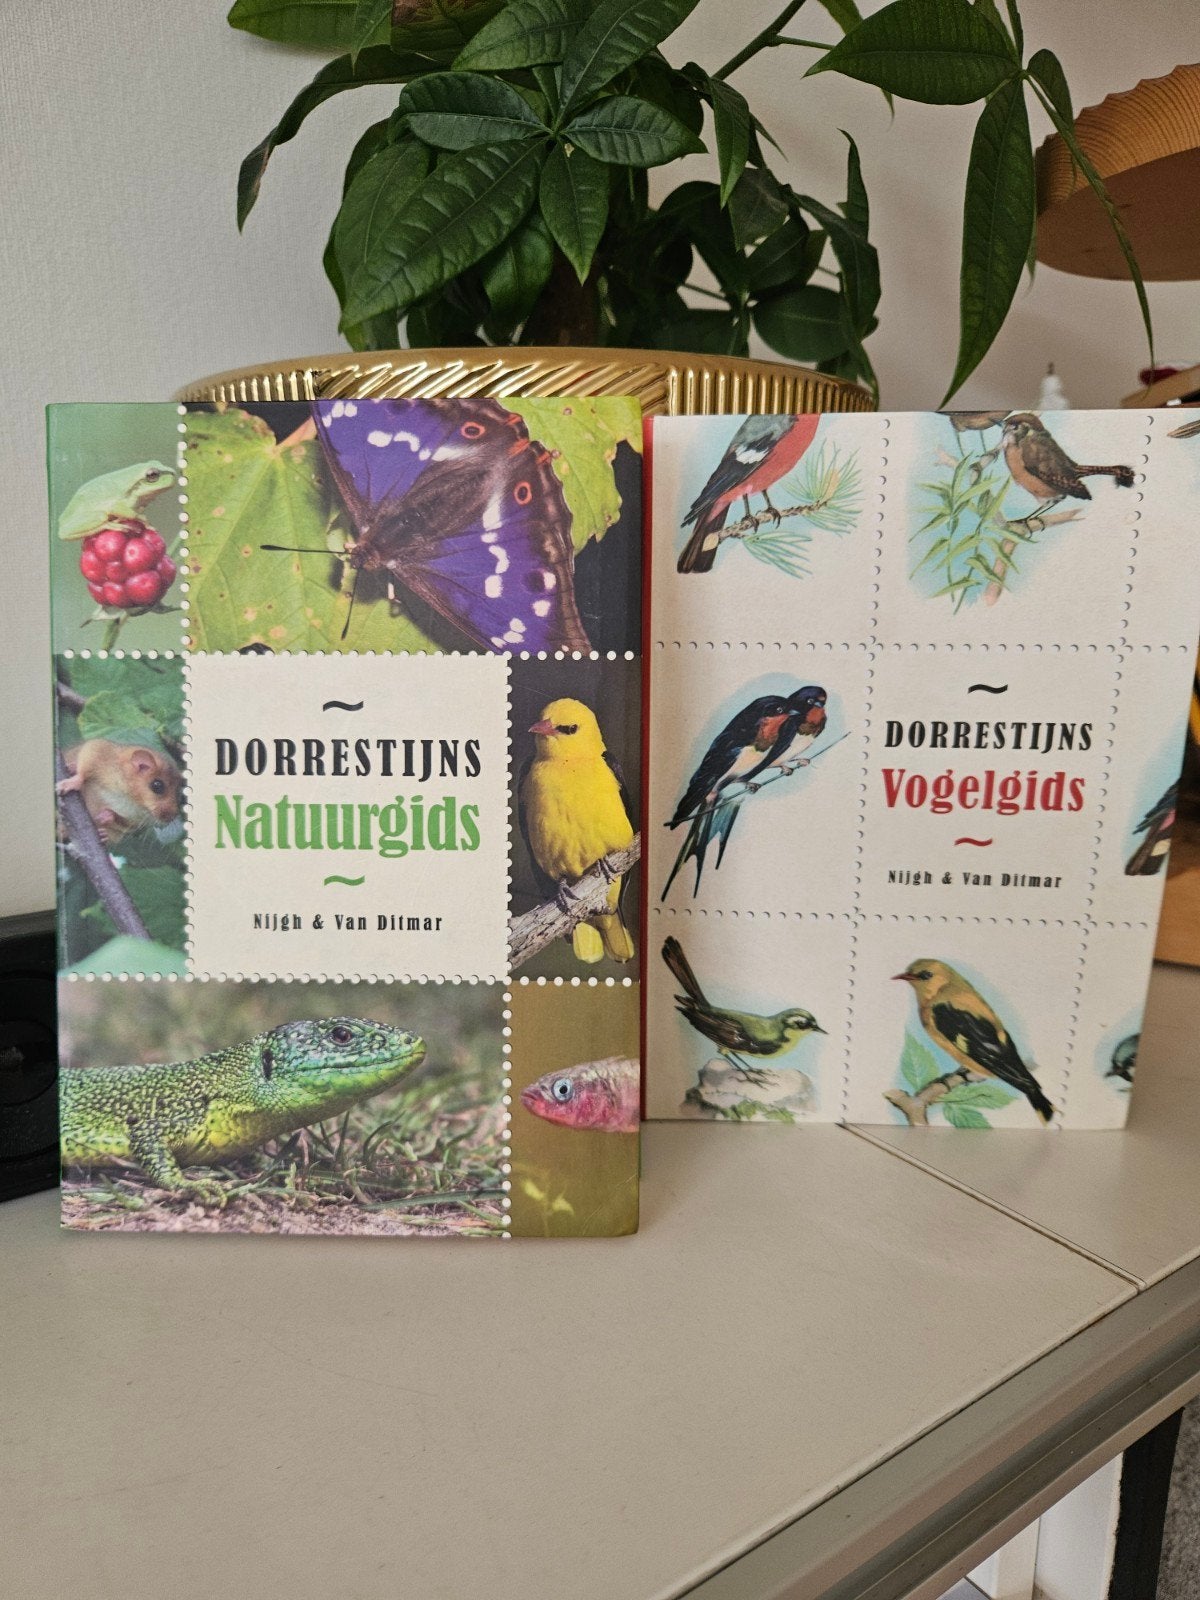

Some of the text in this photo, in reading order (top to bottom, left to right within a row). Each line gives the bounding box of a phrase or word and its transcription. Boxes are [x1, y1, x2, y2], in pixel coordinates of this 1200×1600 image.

[884, 720, 1094, 755] DORRESTIJNS
[214, 737, 482, 783] DORRESTIJNS
[881, 768, 1086, 816] Vogelgids
[213, 794, 482, 859] Natuurgids
[888, 870, 1062, 888] Nijgh & Van Ditmar
[253, 912, 443, 932] Nijgh & Van Ditmar
